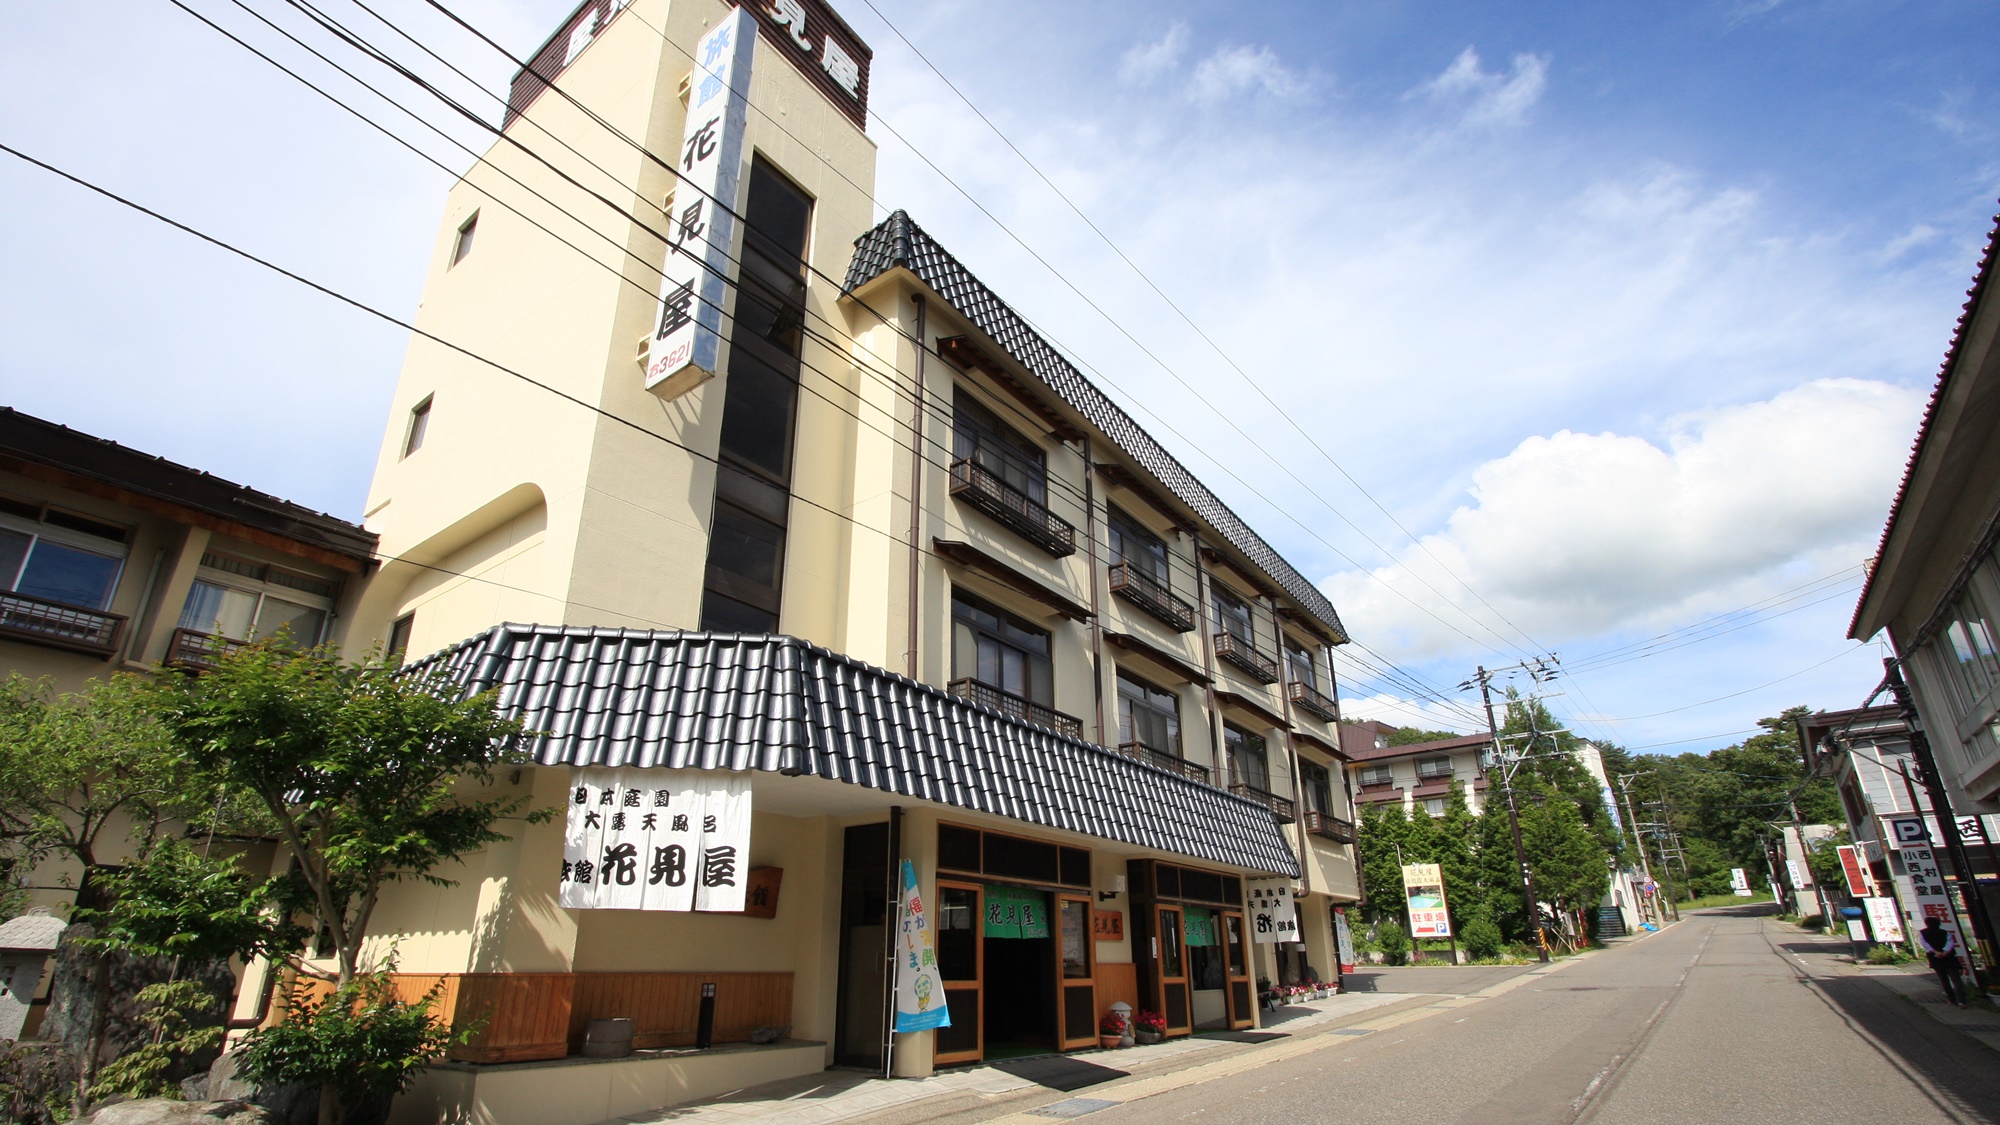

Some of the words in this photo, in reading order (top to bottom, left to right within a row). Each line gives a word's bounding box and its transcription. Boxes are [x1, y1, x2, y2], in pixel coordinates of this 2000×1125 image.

[697, 26, 731, 110] 旅館
[656, 115, 720, 342] 花見屋
[575, 787, 670, 808] 日本庭園
[1896, 822, 1921, 841] P
[600, 842, 737, 888] 花見屋
[1904, 850, 1930, 896] 小西食堂
[1918, 850, 1944, 895] 西村屋
[987, 901, 1036, 926] 花見屋
[1412, 912, 1445, 922] 駐車場
